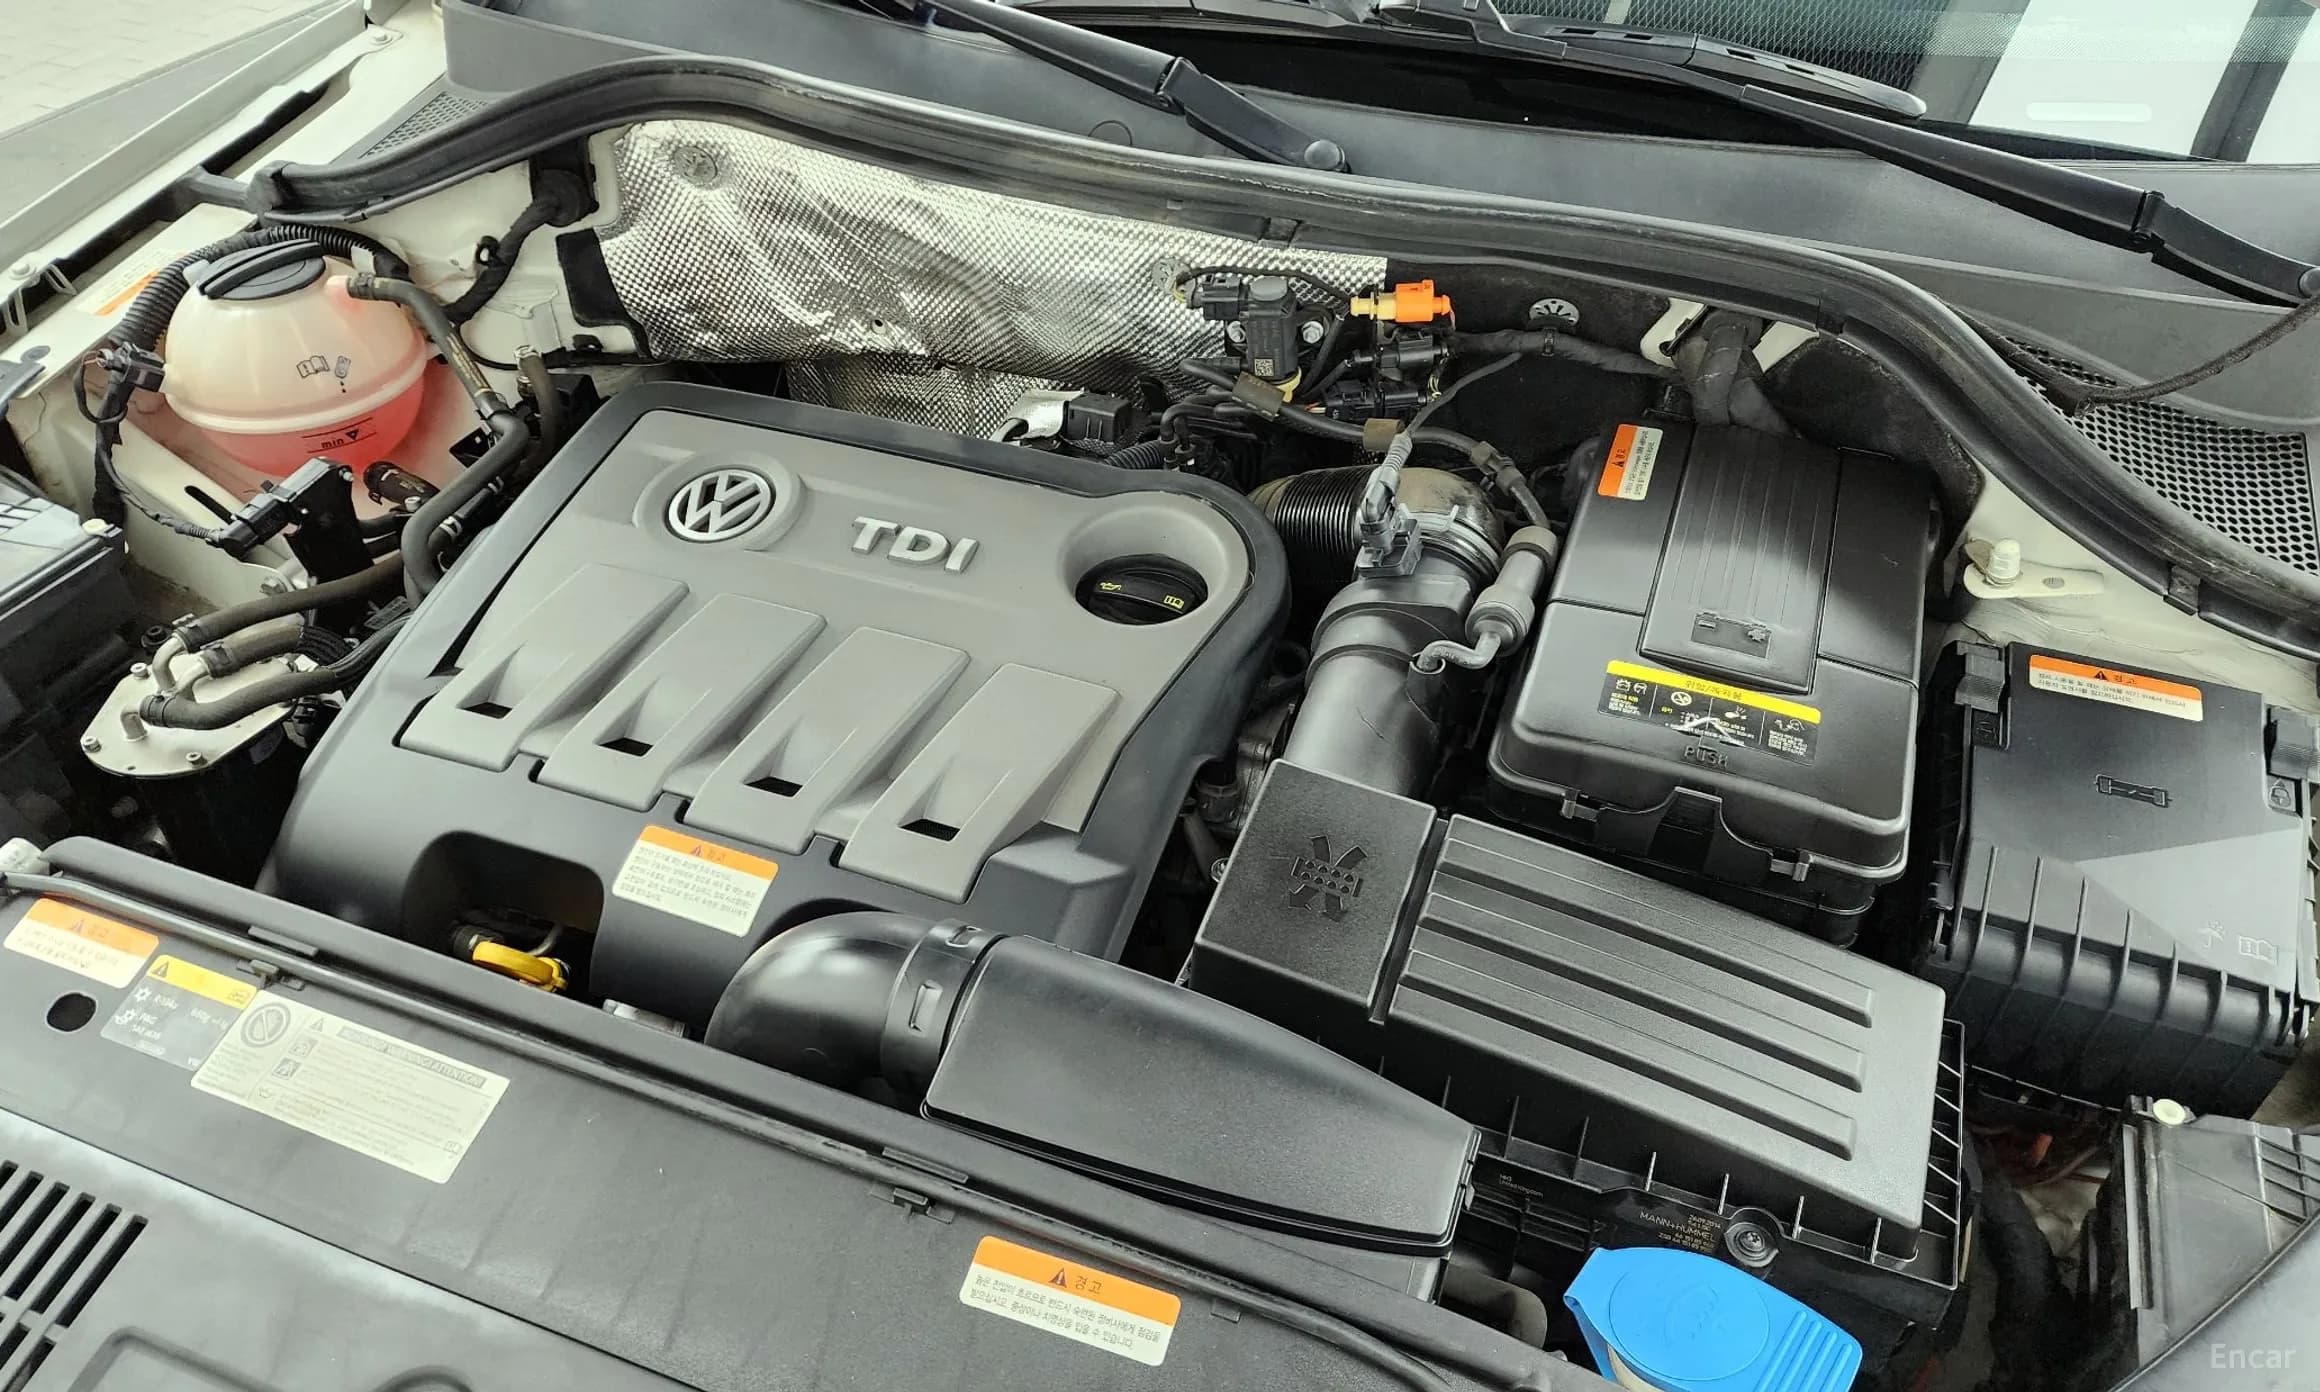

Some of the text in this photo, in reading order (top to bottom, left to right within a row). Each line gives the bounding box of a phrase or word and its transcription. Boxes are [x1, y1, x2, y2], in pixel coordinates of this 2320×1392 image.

[321, 438, 344, 449] min
[851, 516, 978, 574] TDI
[1639, 1211, 1717, 1242] MANN+HUMMEL
[1074, 1276, 1102, 1294] 경고
[1048, 1298, 1072, 1313] 반드시
